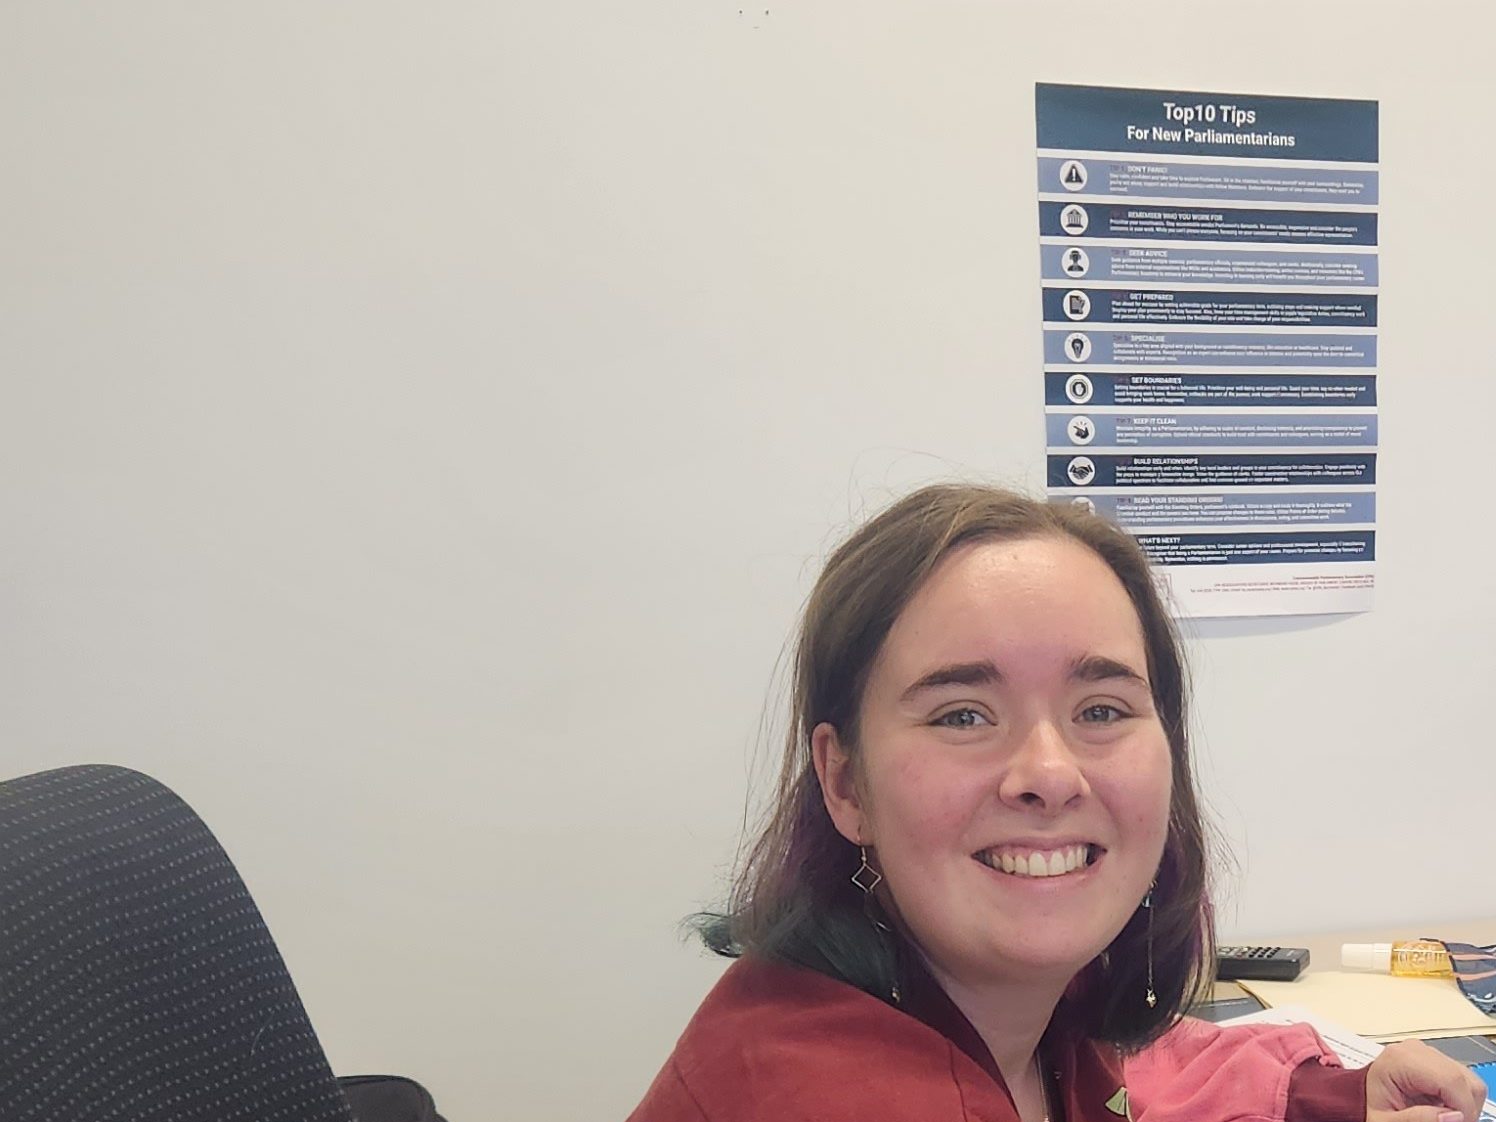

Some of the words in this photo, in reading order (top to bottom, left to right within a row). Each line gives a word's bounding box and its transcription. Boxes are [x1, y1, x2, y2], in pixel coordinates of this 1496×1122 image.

[1163, 102, 1216, 125] Top10
[1220, 105, 1256, 127] Tips
[1127, 126, 1148, 140] For
[1152, 127, 1181, 142] New
[1185, 129, 1295, 147] Parliamentarians
